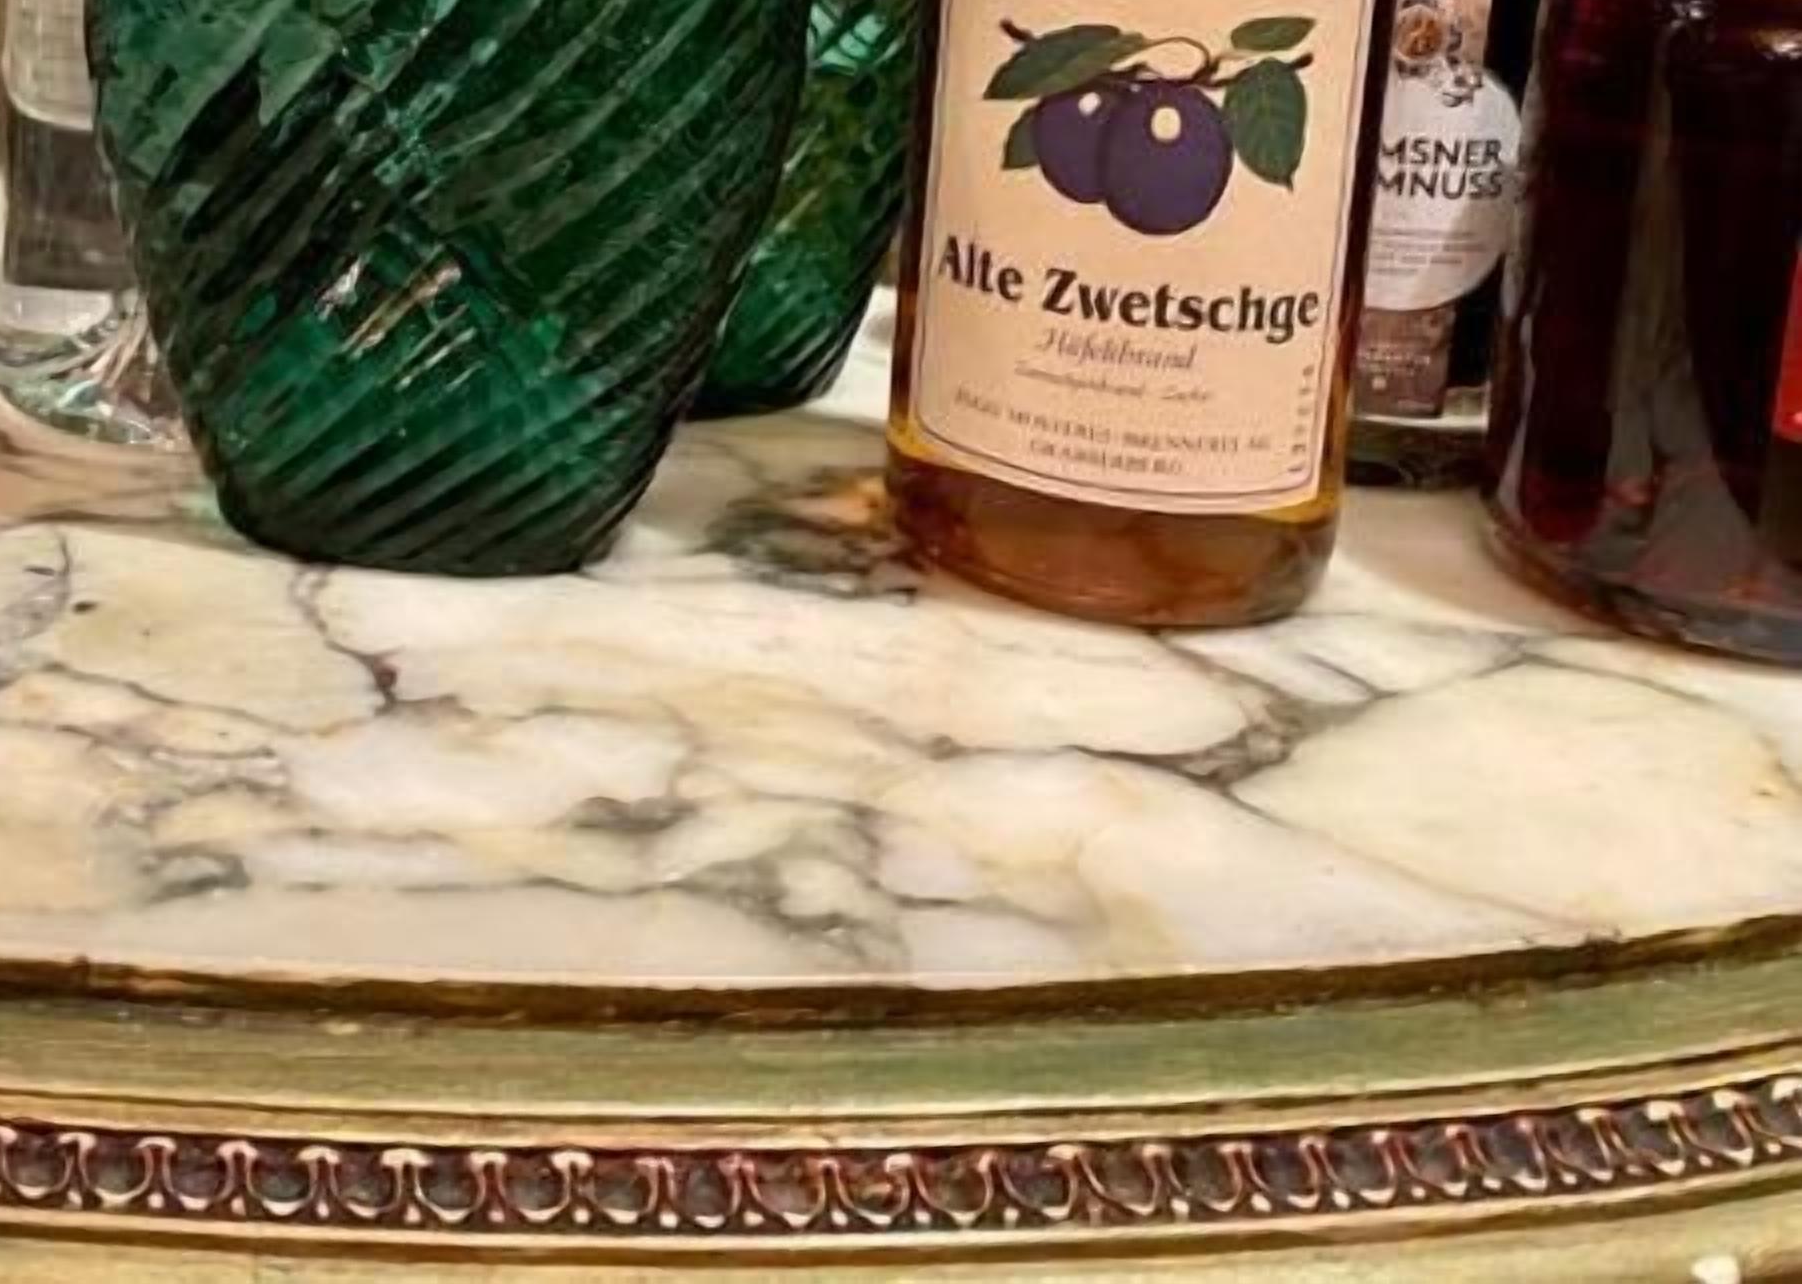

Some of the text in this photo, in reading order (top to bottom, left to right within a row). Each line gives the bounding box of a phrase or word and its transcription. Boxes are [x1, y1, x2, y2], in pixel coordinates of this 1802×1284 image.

[1381, 137, 1503, 166] MSNER
[1377, 171, 1503, 200] MNUSS
[936, 235, 1321, 344] Alte Zwetschge
